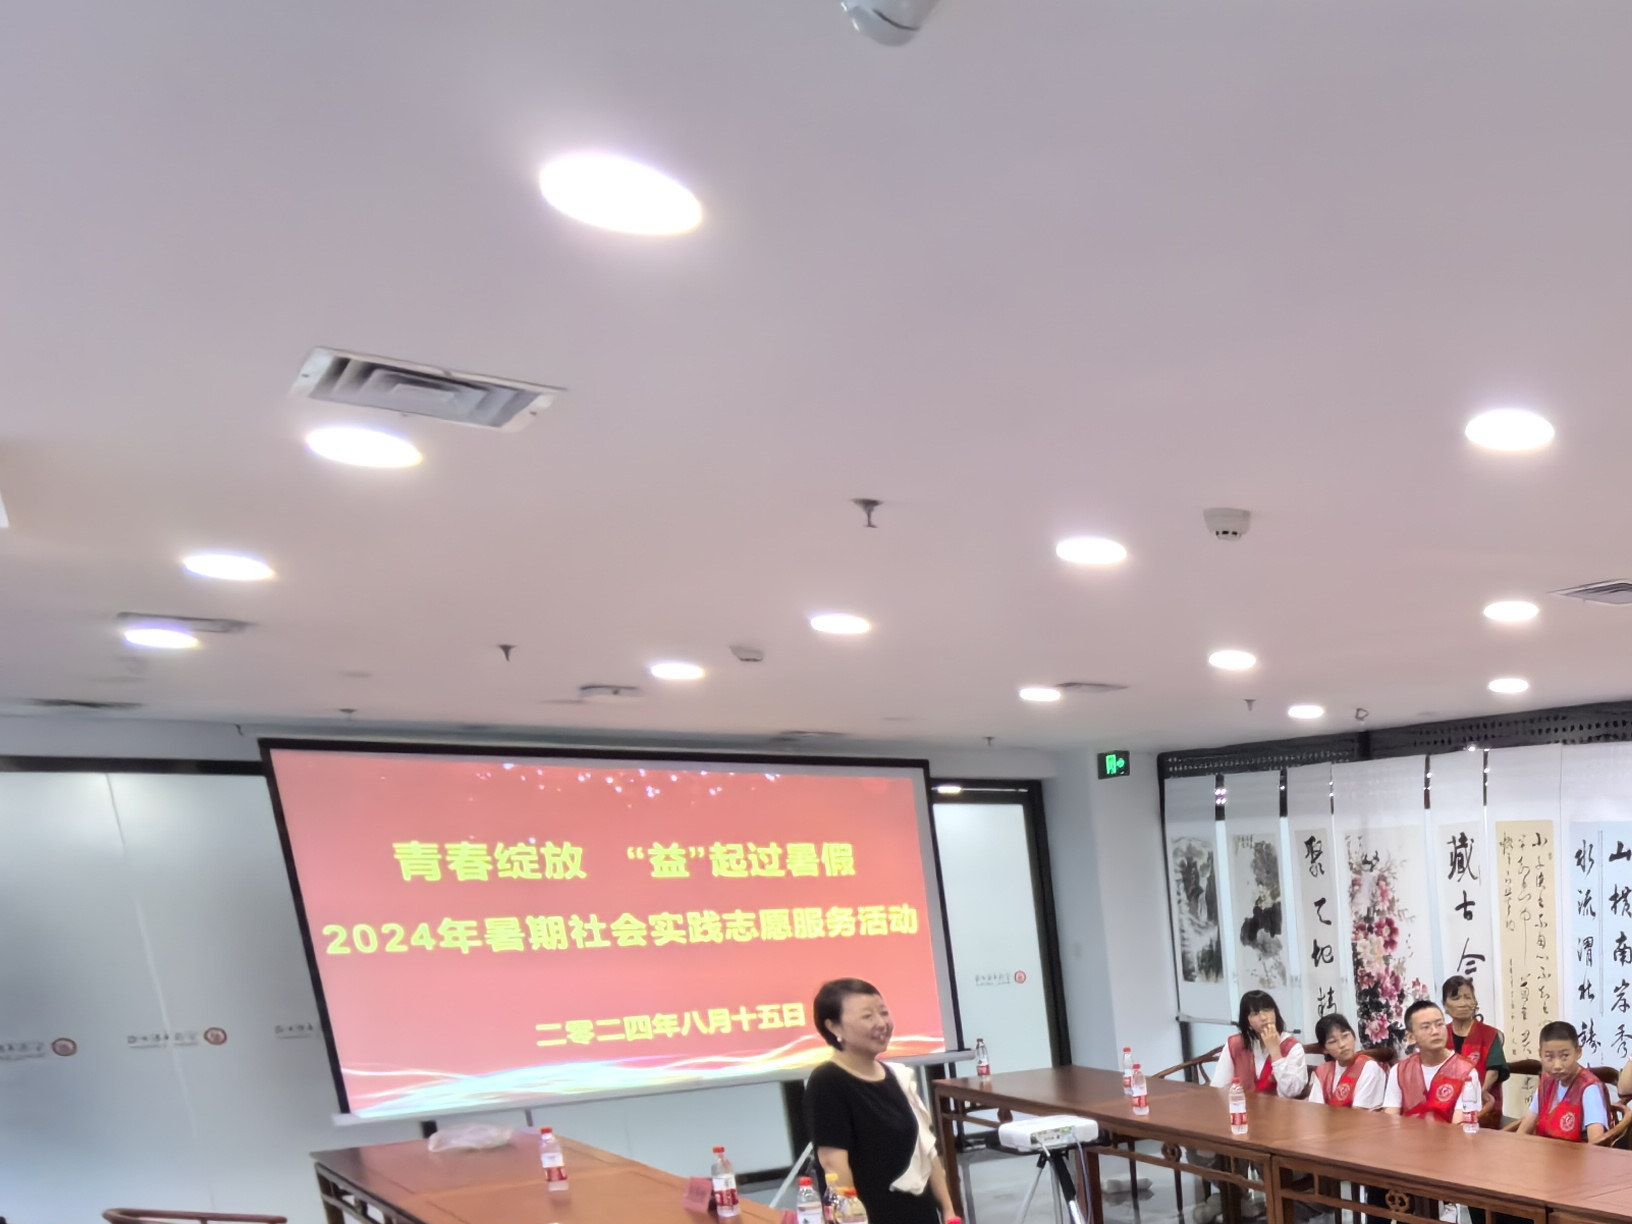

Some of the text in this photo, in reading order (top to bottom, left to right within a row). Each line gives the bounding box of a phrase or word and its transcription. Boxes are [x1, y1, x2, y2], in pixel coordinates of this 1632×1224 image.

[393, 839, 588, 882] 青春绽放
[323, 904, 919, 956] 2024年暑期社会实践志愿服务活动
[534, 1001, 806, 1048] 二零二四年八月十五日
